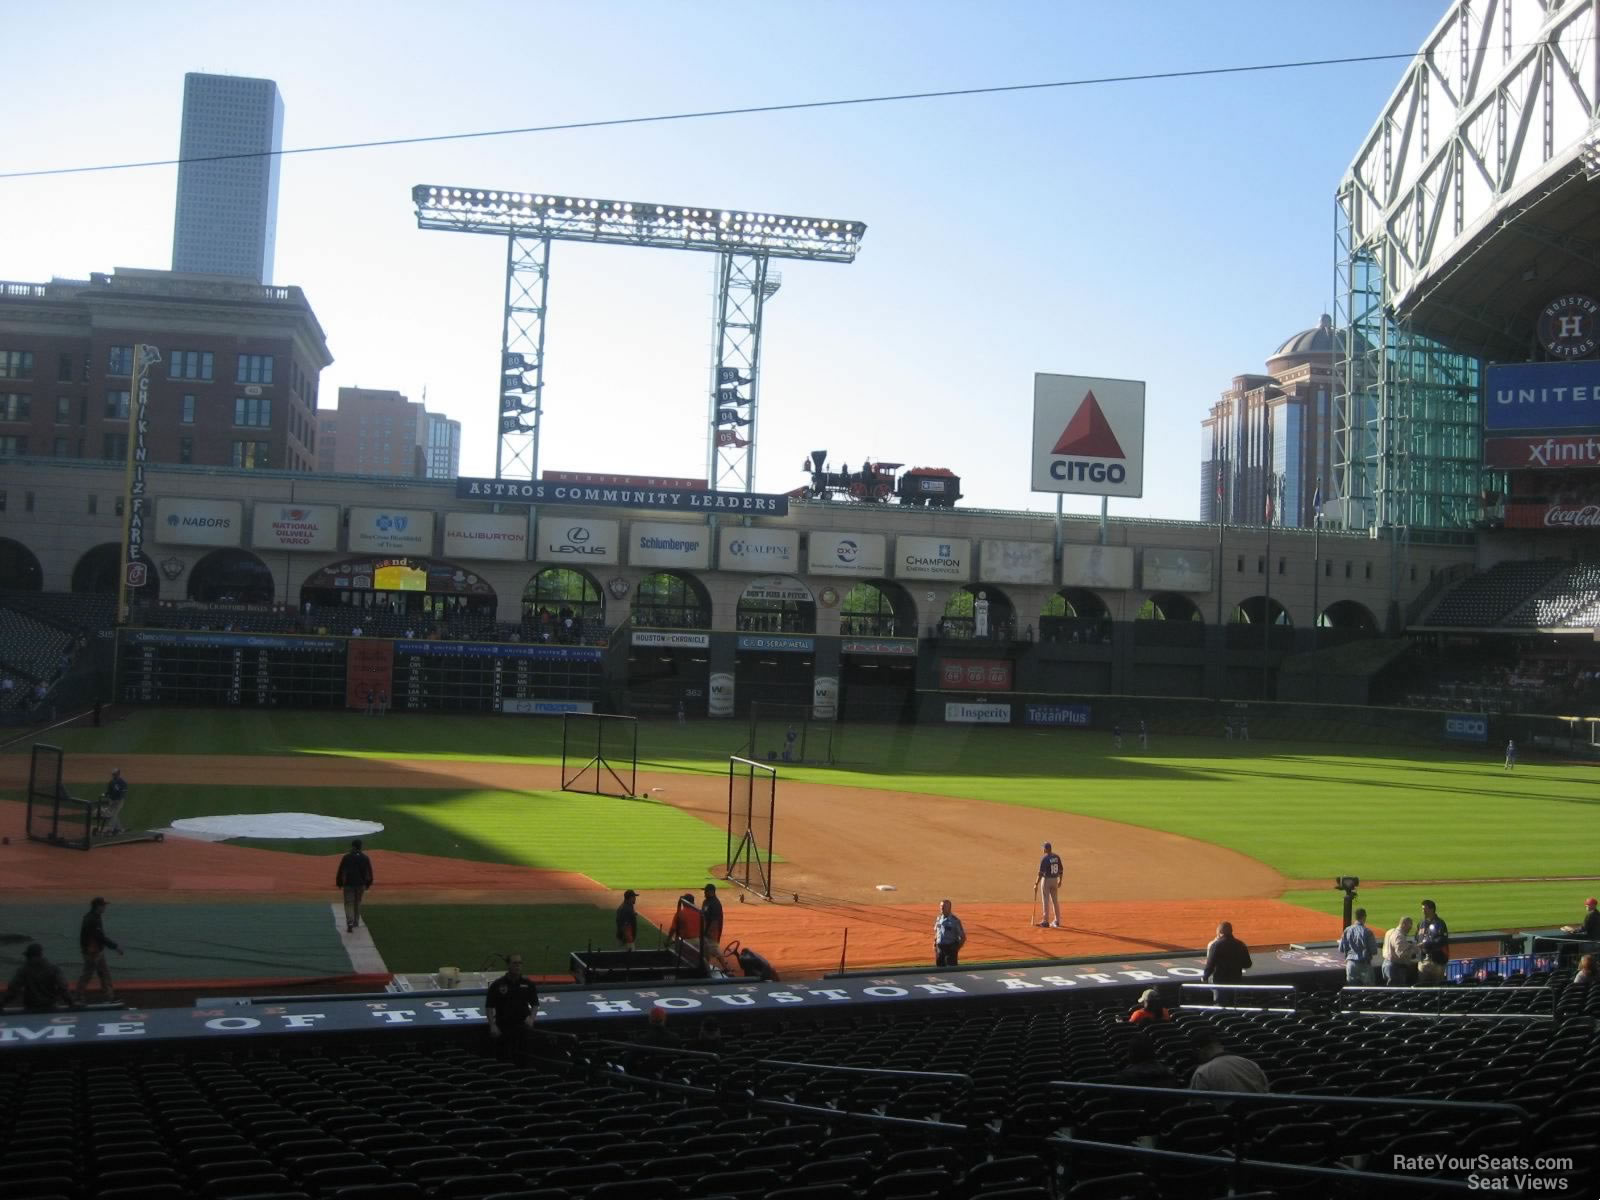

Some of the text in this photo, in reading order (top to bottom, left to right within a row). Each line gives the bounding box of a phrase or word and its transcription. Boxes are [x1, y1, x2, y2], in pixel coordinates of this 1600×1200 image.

[1545, 296, 1598, 317] HOUSTON
[1558, 315, 1583, 338] H
[1547, 339, 1595, 356] ASTROS
[722, 371, 735, 380] 99
[722, 392, 733, 400] 01
[505, 399, 517, 408] 97
[721, 412, 733, 421] 04
[720, 433, 732, 442] 05
[1050, 460, 1126, 483] CITGO
[469, 482, 777, 511] ASTROS COMMUNITY LEADERS
[182, 516, 231, 528] NABORS
[272, 522, 320, 531] NATIONAL
[276, 530, 314, 538] OILWELL
[447, 530, 525, 542] HALLIBURTON
[280, 537, 310, 545] VARCO
[639, 536, 700, 553] Schlumberger
[549, 544, 607, 555] LEXUS
[906, 555, 960, 567] CHAMPION
[635, 634, 706, 645] HOUSTON CHRONICLE
[766, 640, 787, 649] SCRAP
[787, 640, 809, 649] METAL
[960, 707, 1009, 720] Insperity
[1029, 708, 1088, 724] TexanPlus
[1446, 719, 1485, 734] GEICO
[204, 1013, 326, 1031] OF
[371, 1006, 548, 1024] TH
[585, 981, 967, 1014] HOUSTON
[996, 966, 1206, 990] ASTRO
